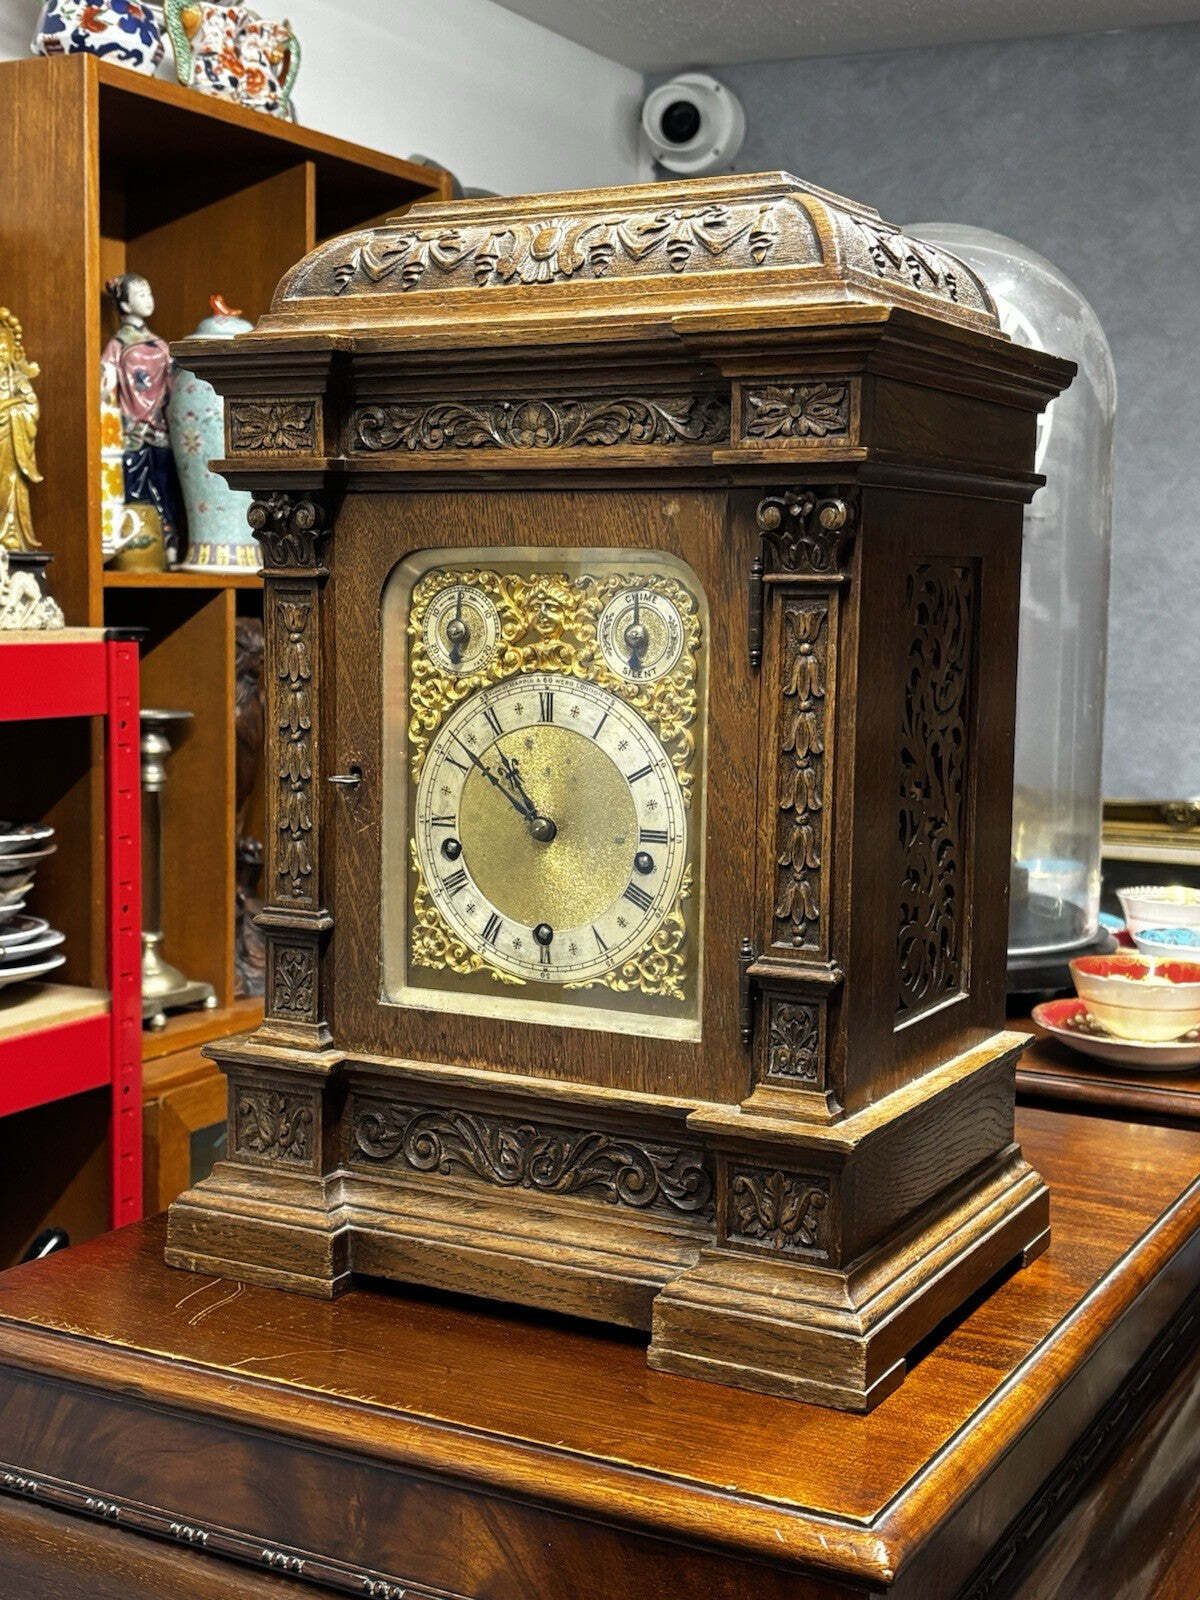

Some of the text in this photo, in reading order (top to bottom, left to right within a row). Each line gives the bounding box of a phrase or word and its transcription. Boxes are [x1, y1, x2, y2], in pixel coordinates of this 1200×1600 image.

[625, 592, 657, 604] CHIME
[622, 667, 657, 679] SILENT
[537, 692, 555, 723] XII
[481, 705, 504, 736] XI
[444, 751, 470, 778] X
[626, 761, 654, 786] II
[639, 826, 669, 844] III
